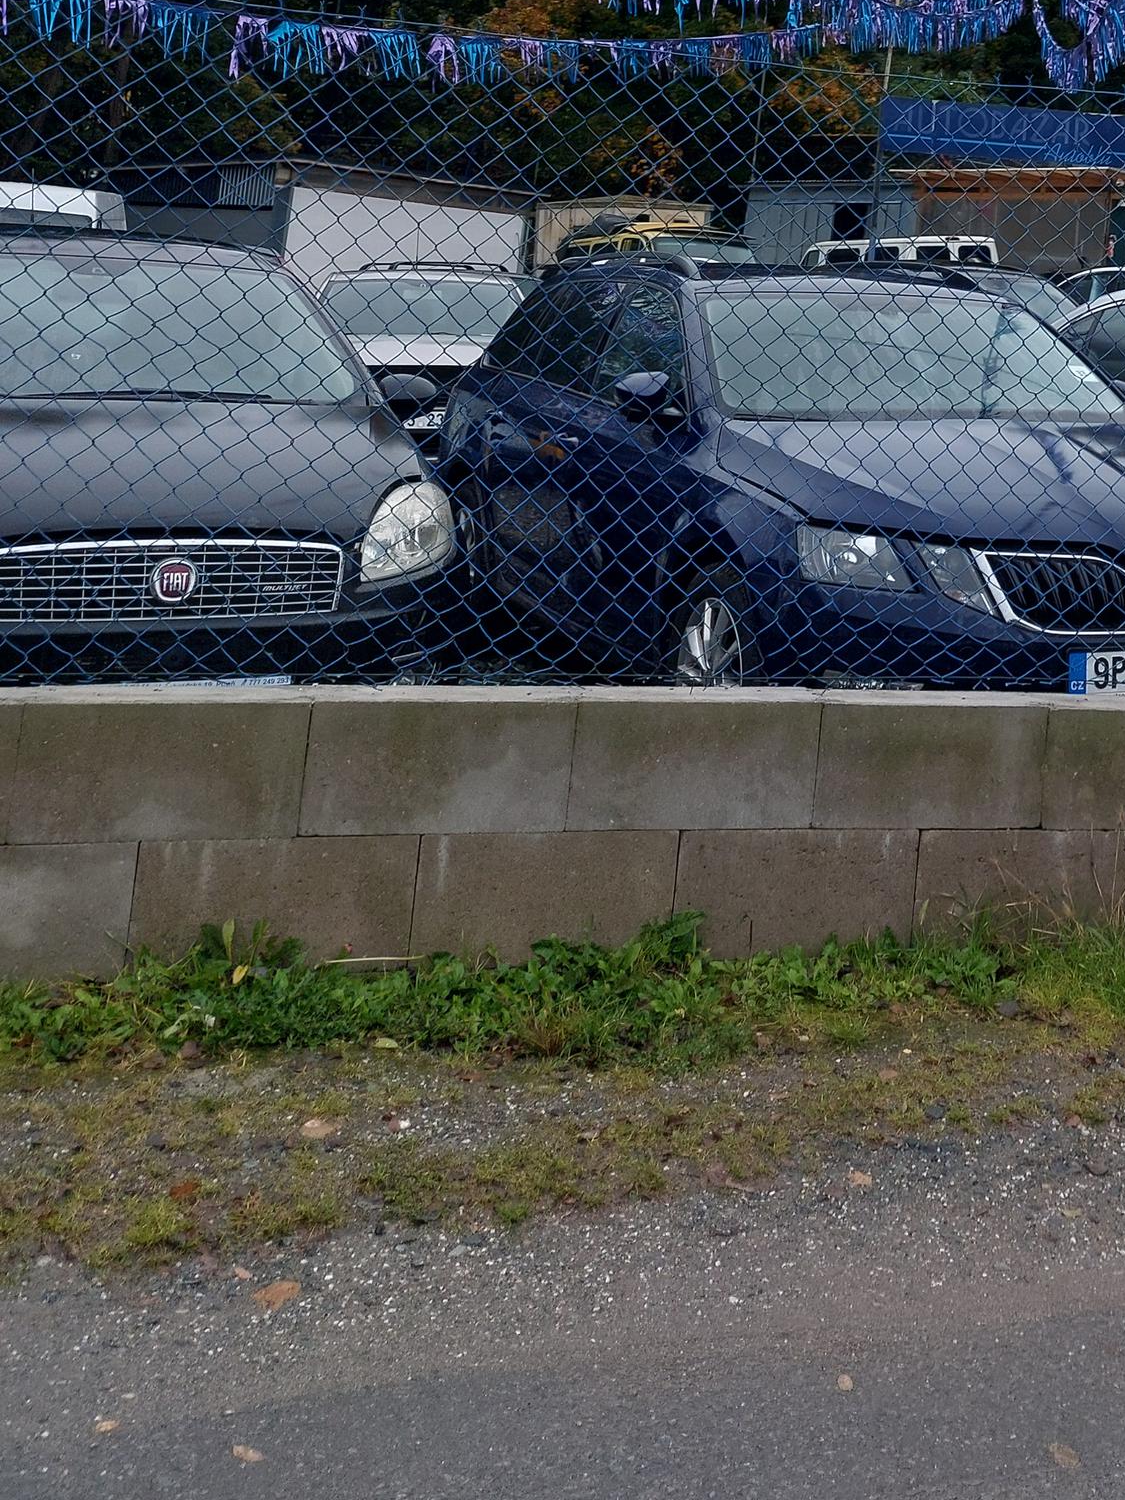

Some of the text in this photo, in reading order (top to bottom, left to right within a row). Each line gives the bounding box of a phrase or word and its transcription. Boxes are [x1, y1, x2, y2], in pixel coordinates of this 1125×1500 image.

[894, 100, 1090, 145] AUTOBAZAR
[162, 572, 188, 592] FIAT
[1070, 680, 1085, 691] CZ
